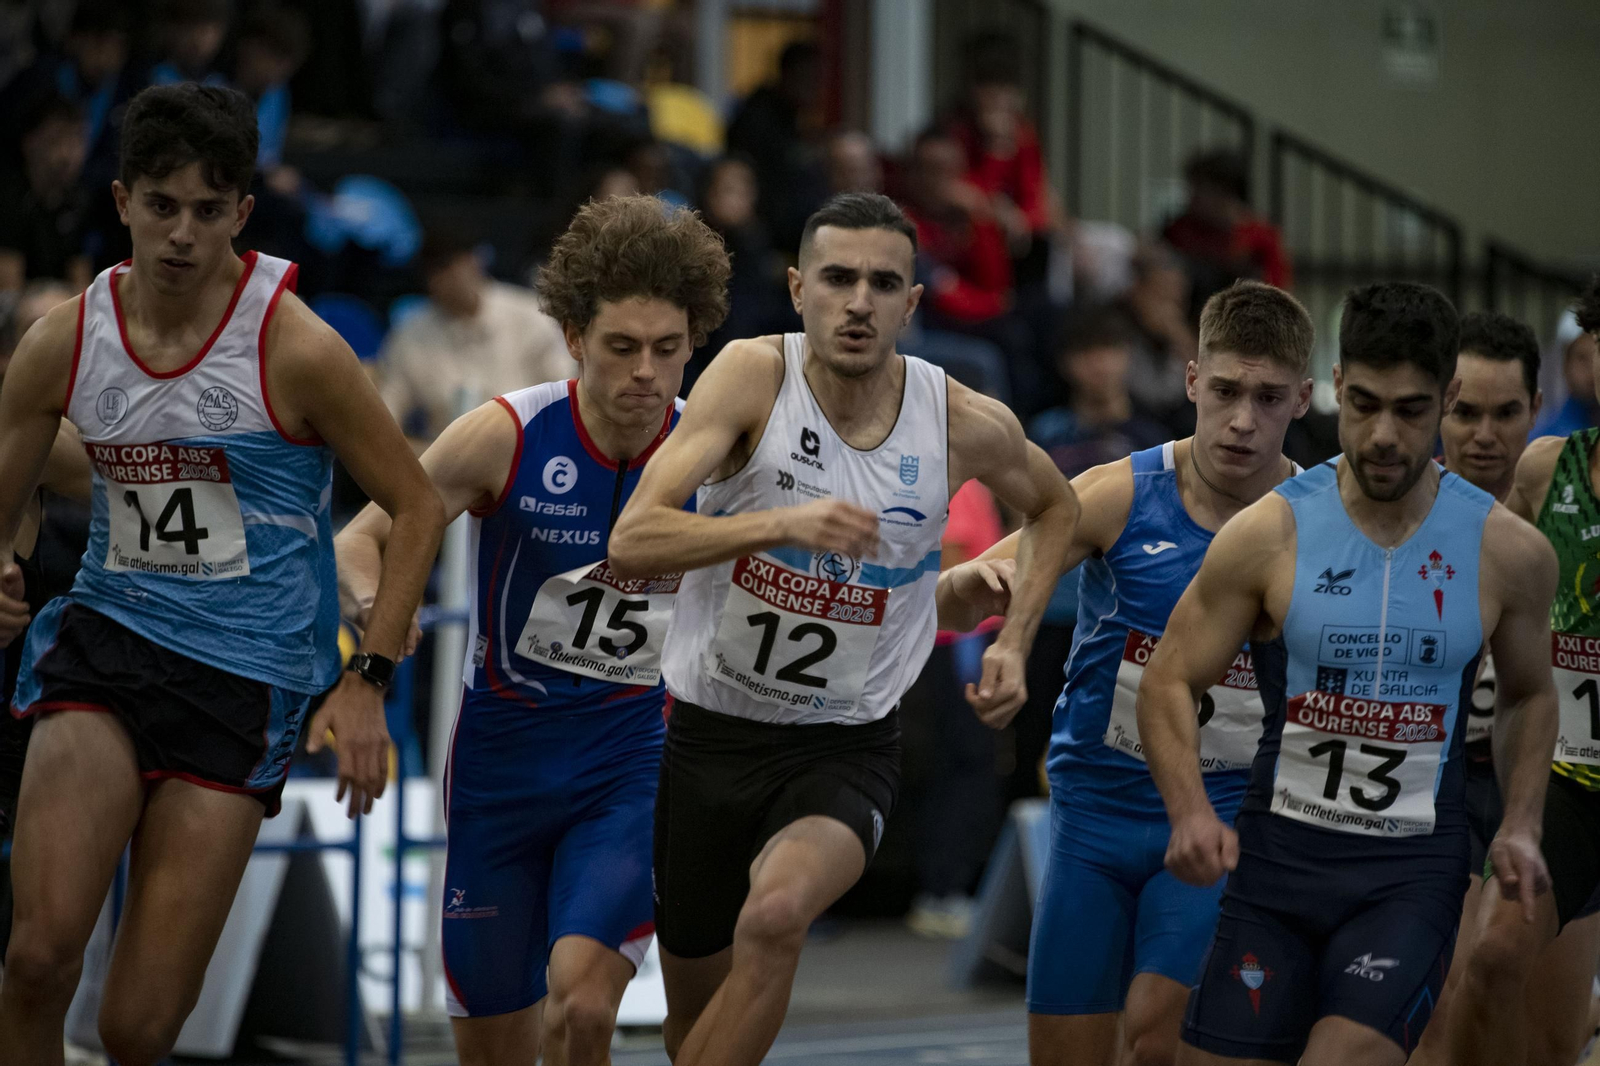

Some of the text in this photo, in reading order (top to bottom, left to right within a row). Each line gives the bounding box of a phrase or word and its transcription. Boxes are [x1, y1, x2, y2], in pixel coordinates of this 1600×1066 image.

[93, 445, 211, 463] XXI COPA ABS
[97, 463, 221, 482] OURENSE 2026
[536, 502, 588, 517] rasán
[124, 488, 208, 554] 14
[531, 527, 600, 545] NEXUS
[130, 557, 199, 575] atletismo.gal
[217, 559, 244, 568] DEPORTE
[218, 565, 243, 574] GALEGO
[746, 557, 874, 605] XXI COPA ABS
[740, 573, 875, 622] OURENSE 2026
[566, 587, 649, 657] 15
[1328, 633, 1402, 644] CONCELLO
[1557, 634, 1581, 652] XXI
[747, 611, 837, 688] 12
[1334, 648, 1392, 658] DE VIGO
[550, 650, 627, 676] atletismo.gal
[1557, 651, 1600, 671] OURE
[1225, 669, 1258, 688] 202
[1353, 670, 1408, 682] XUNTA
[735, 672, 813, 705] atletismo.gal
[1351, 684, 1437, 696] DE GALICIA
[1303, 692, 1433, 722] XXI COPA ABS
[1298, 709, 1438, 741] OURENSE 2026
[1308, 740, 1407, 811] 13
[1303, 803, 1386, 830] atletismo.gal
